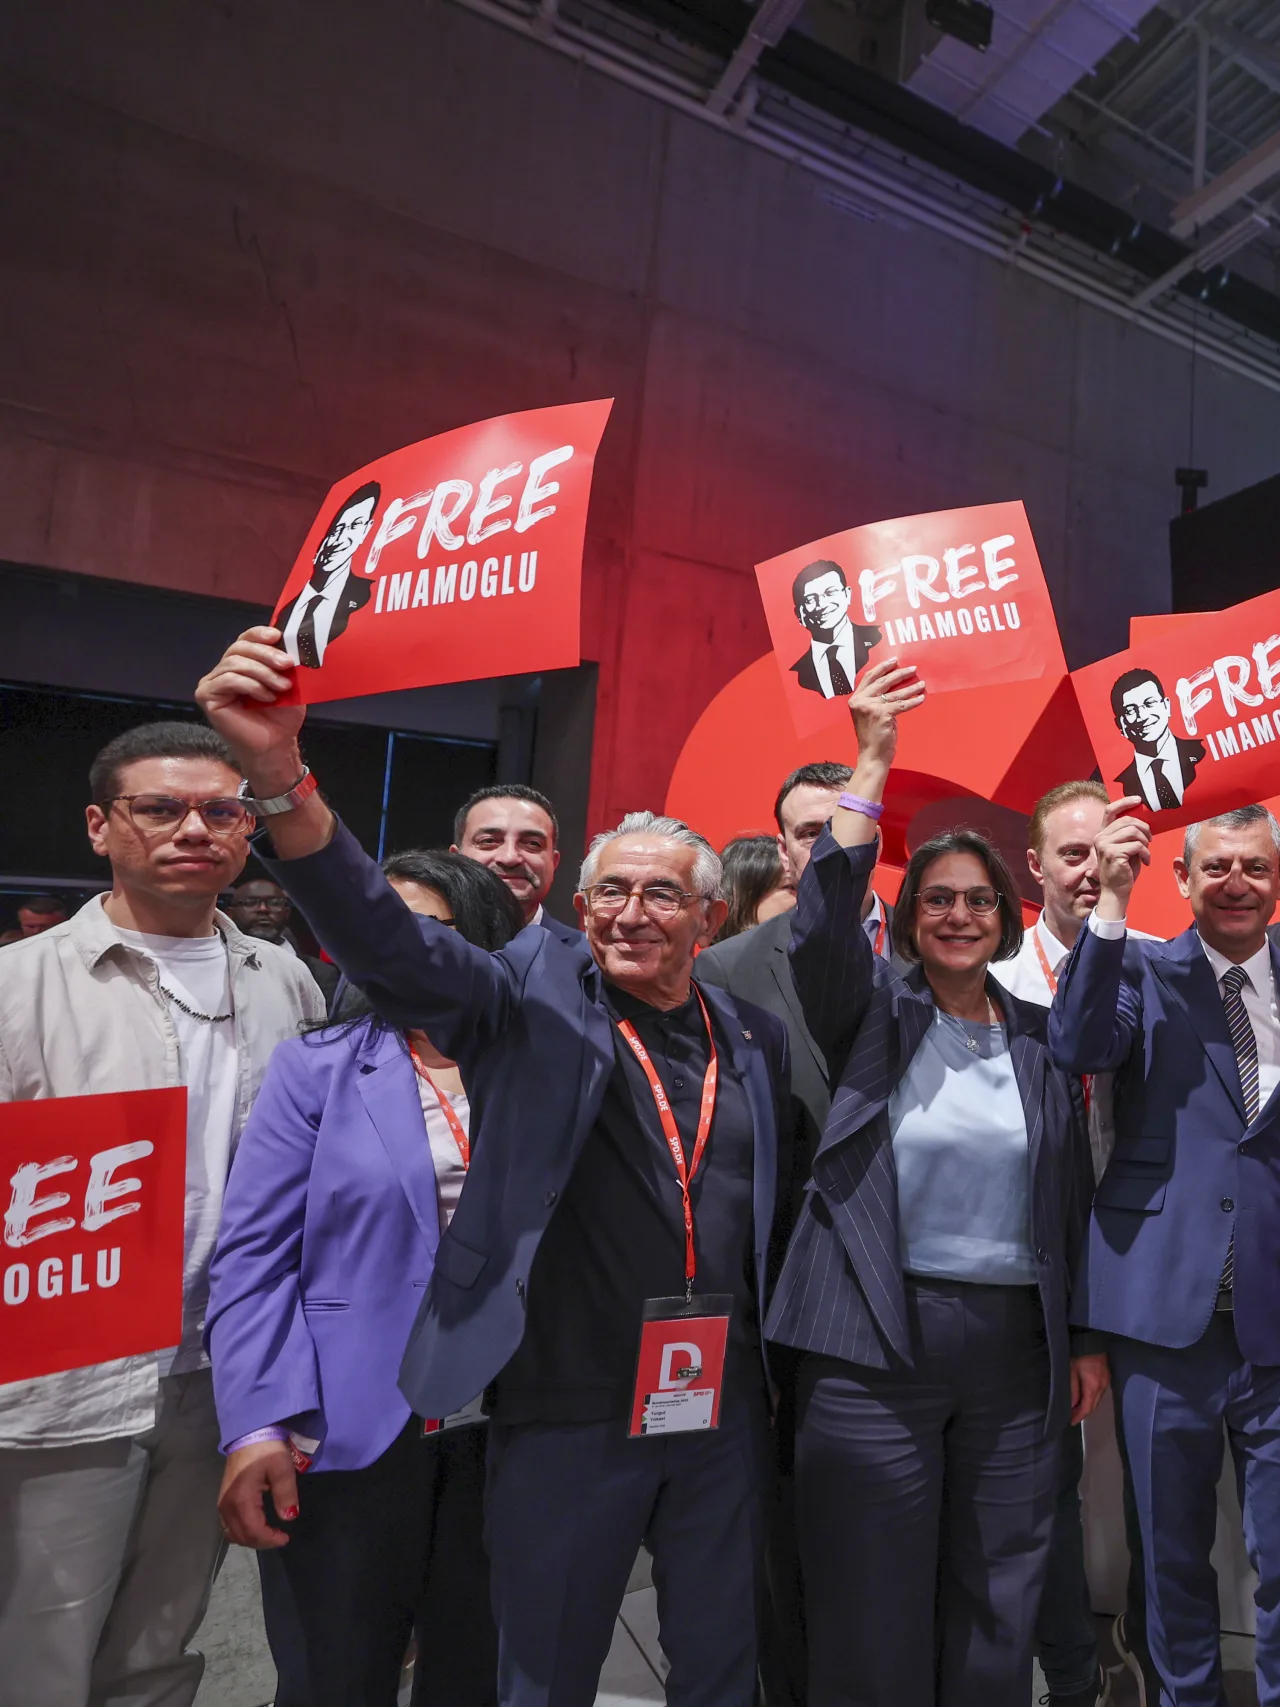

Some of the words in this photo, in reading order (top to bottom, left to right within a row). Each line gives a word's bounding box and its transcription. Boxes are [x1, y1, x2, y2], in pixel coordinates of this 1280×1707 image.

[364, 444, 574, 573] FREE
[375, 551, 538, 614] IMAMOGLU
[857, 534, 1020, 622] FREE
[884, 601, 1022, 647] IMAMOGLU
[628, 1036, 649, 1062] SPD.DE
[652, 1084, 669, 1112] SPD.DE
[669, 1136, 683, 1166] SPD.DE
[0, 1140, 154, 1248] EE
[658, 1342, 702, 1390] D
